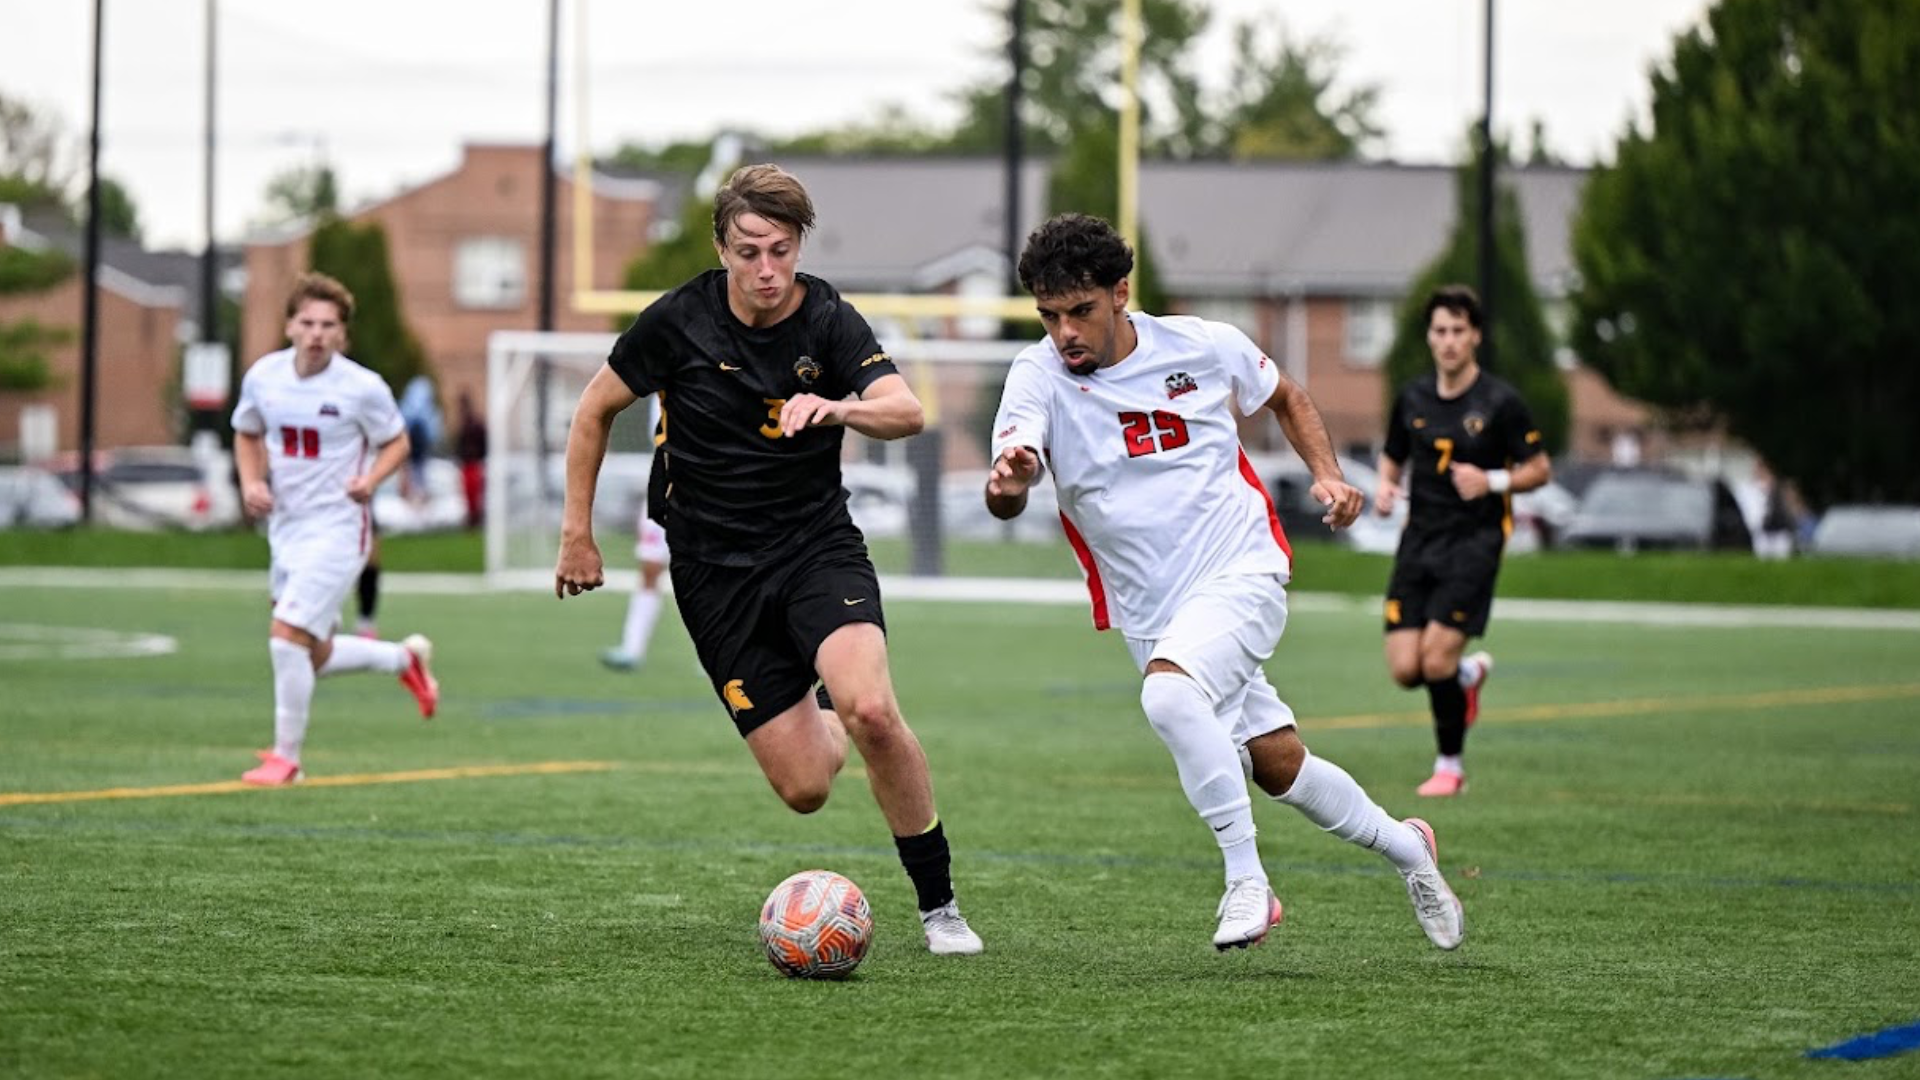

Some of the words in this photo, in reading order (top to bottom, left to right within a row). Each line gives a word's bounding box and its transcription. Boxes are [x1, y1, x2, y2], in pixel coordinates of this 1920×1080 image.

[759, 399, 787, 439] 3
[1117, 410, 1190, 458] 29
[1433, 437, 1454, 475] 7
